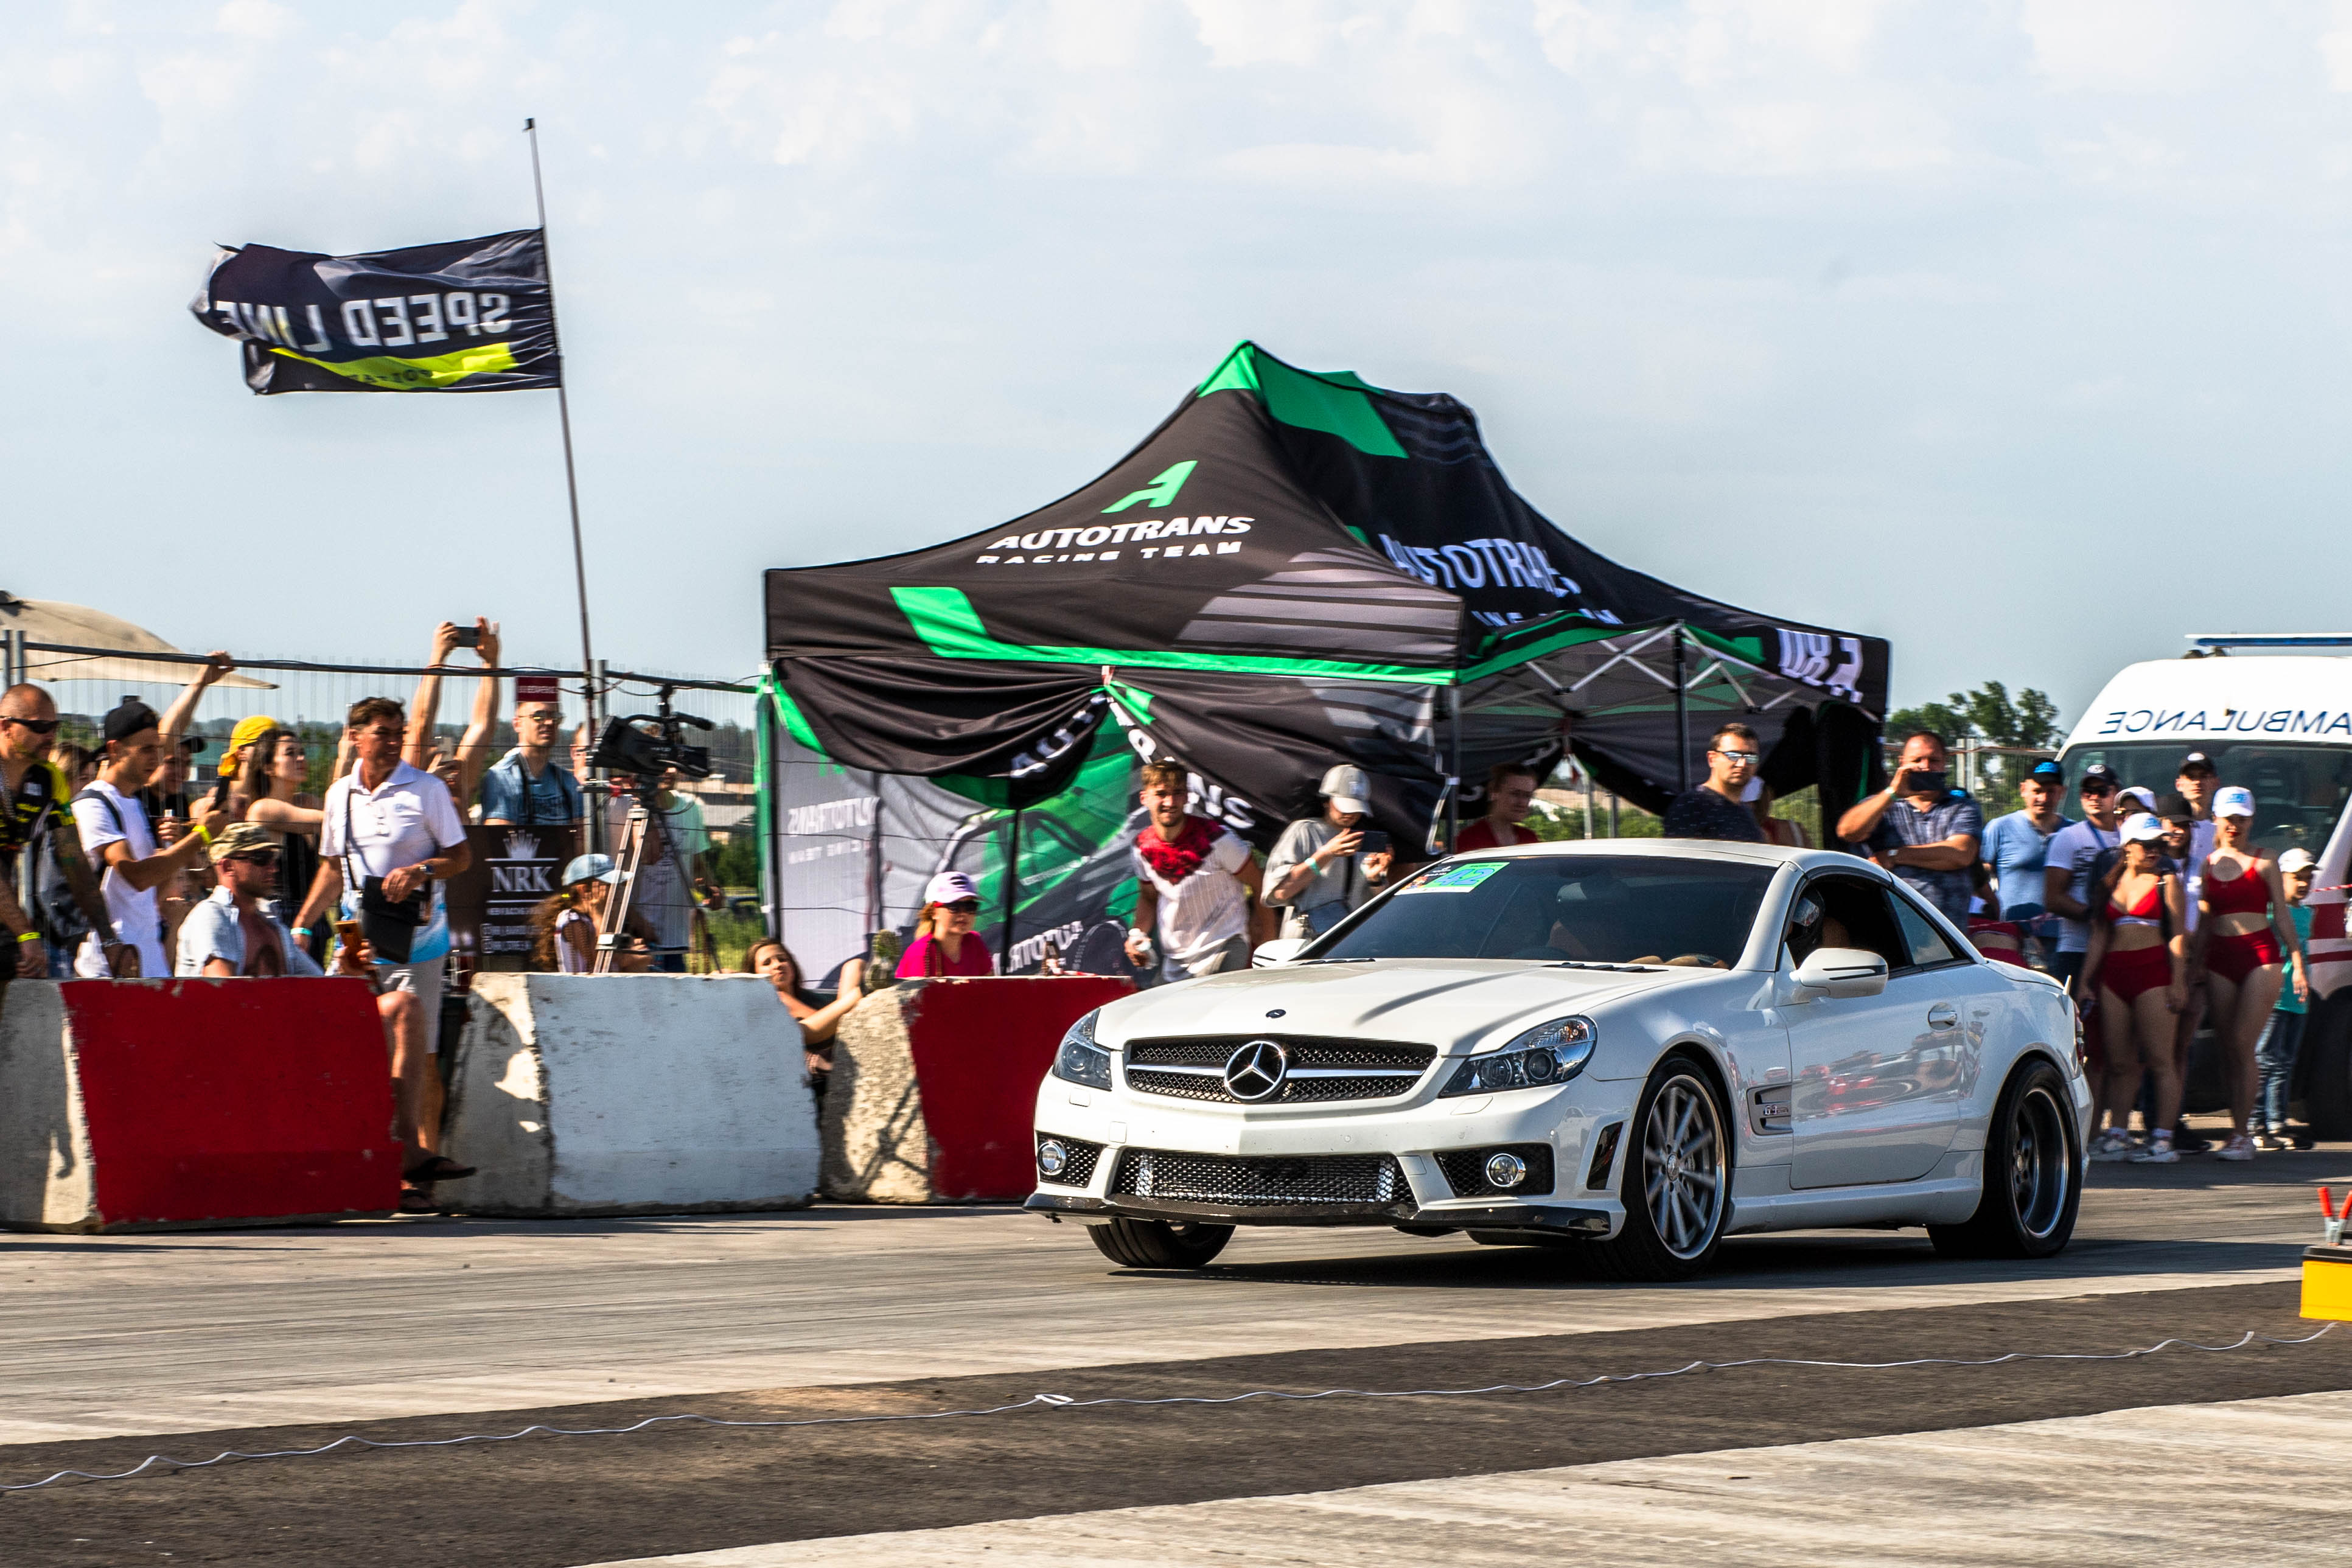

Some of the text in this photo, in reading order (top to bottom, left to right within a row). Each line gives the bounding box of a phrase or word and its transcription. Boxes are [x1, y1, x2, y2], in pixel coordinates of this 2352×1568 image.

[985, 516, 1255, 550] AUTOTRANS
[975, 541, 1242, 564] RACING TEAM
[490, 866, 554, 892] NRK
[1434, 868, 1495, 886] 42
